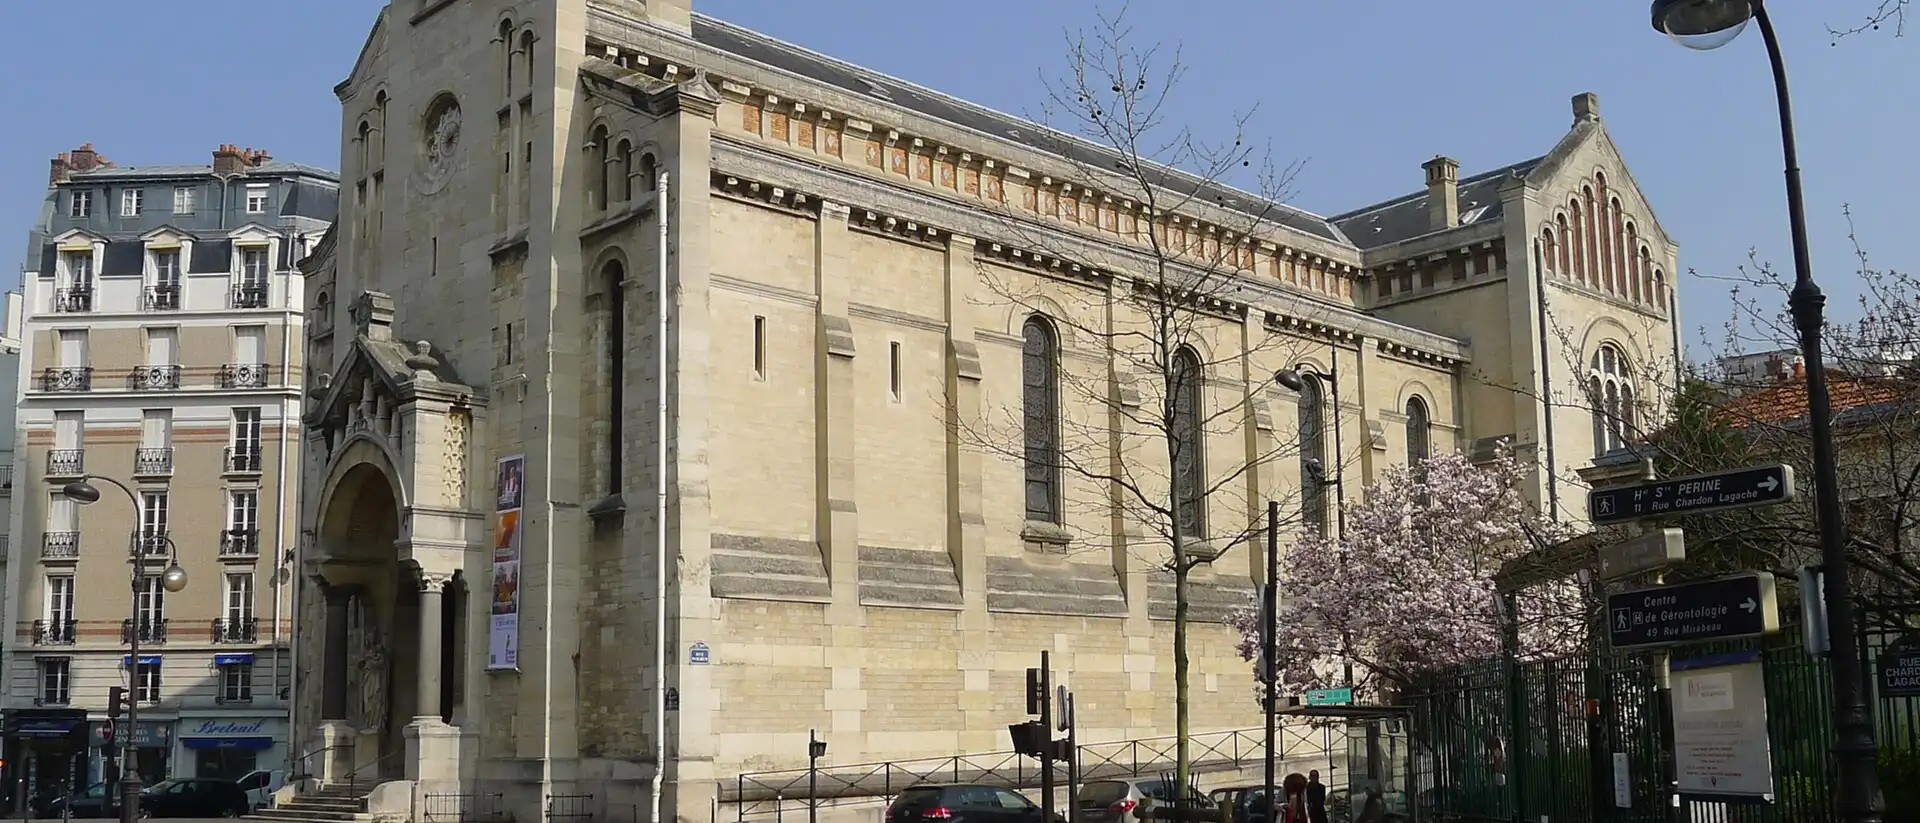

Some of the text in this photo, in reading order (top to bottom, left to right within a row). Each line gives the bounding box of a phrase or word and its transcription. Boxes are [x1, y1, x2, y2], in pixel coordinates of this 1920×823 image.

[1678, 479, 1721, 495] PERINE
[1634, 490, 1759, 513] 11 Rue Chardon Lagache
[1644, 596, 1677, 608] Centre
[1645, 605, 1728, 624] de Gérontologie
[1663, 626, 1679, 636] Rue
[1682, 623, 1722, 634] Mirabeau
[1900, 657, 1920, 667] RUE
